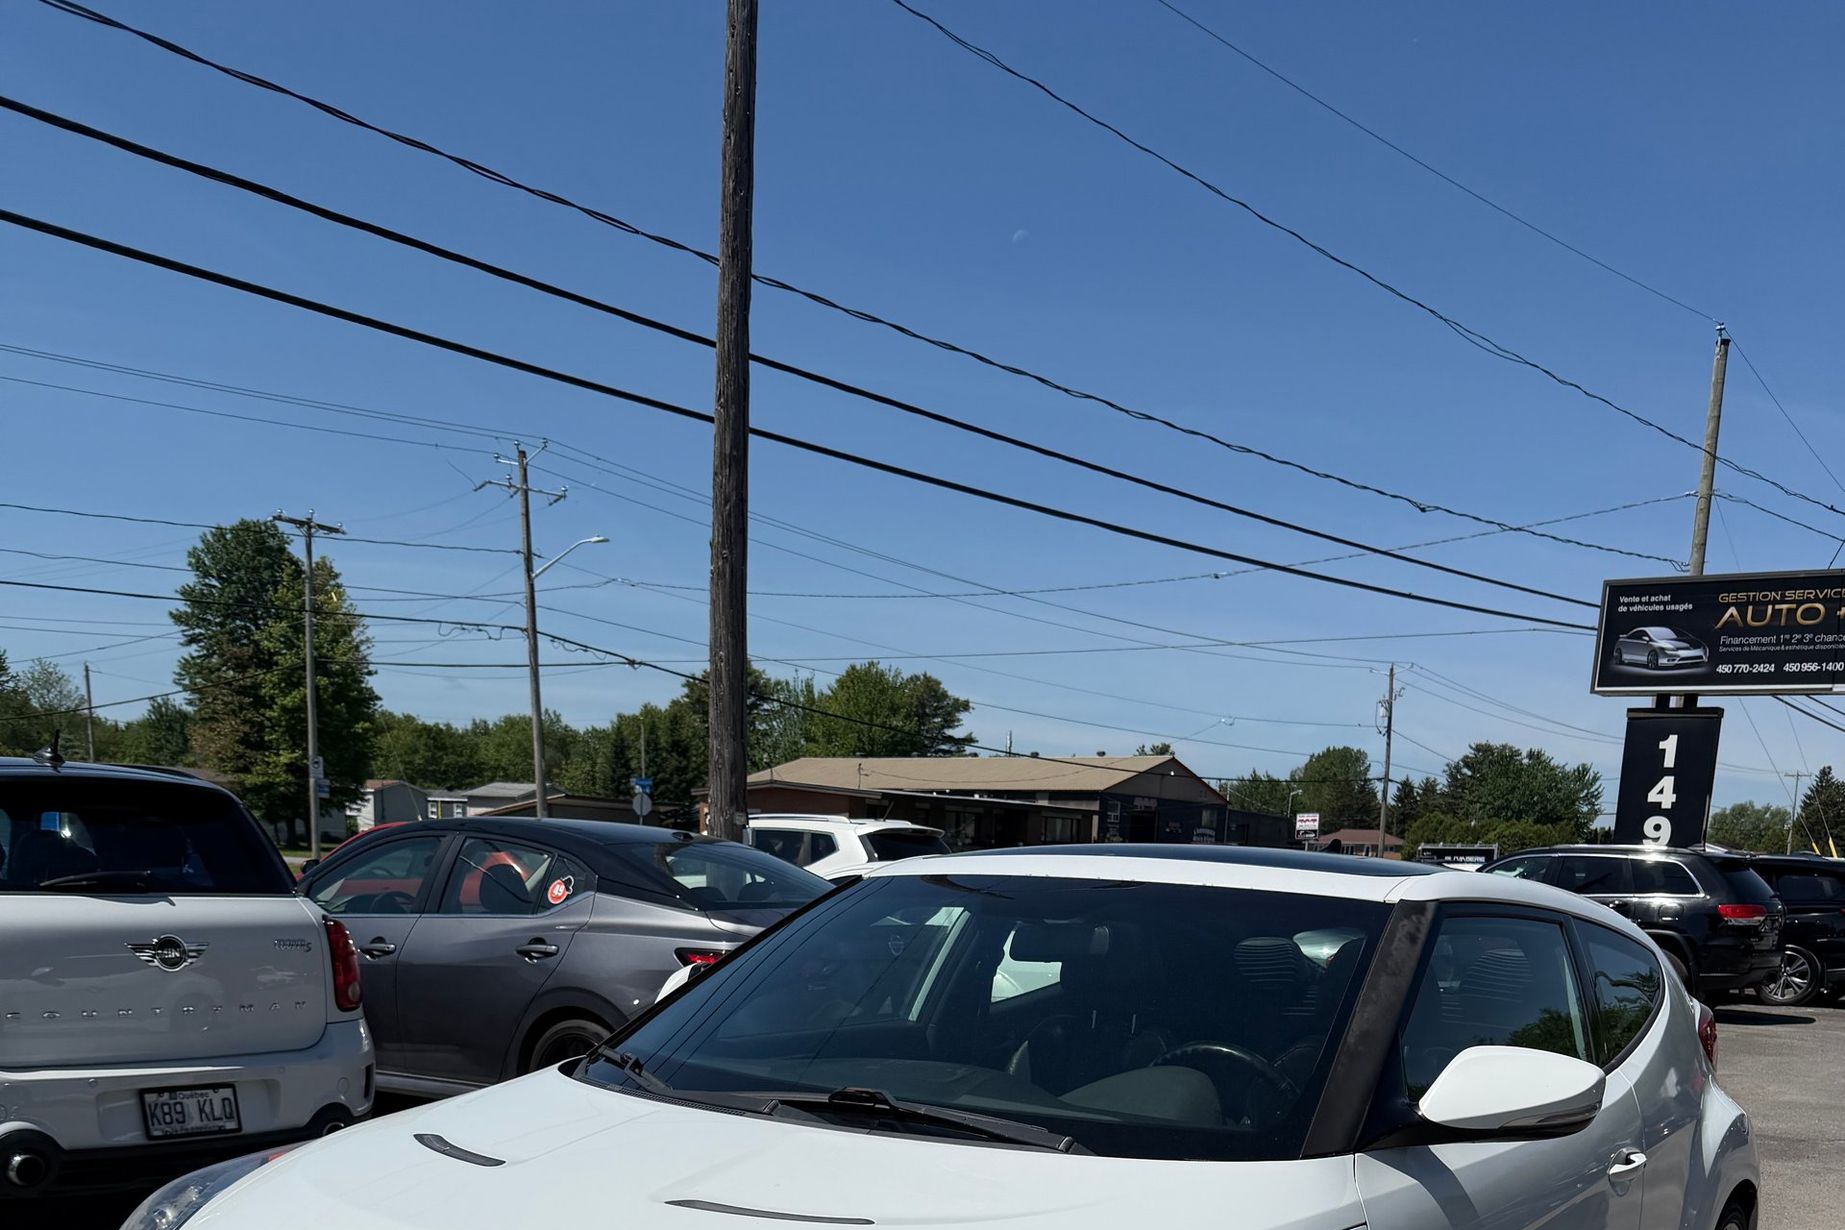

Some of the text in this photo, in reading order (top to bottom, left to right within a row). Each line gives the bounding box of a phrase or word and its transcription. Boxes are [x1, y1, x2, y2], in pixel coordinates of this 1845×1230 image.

[1650, 594, 1671, 602] achat
[1719, 591, 1781, 603] GESTION
[1629, 604, 1664, 612] véhicules
[1665, 602, 1693, 612] usagés
[1714, 603, 1826, 629] AUTO
[1720, 635, 1777, 645] Financement
[1716, 661, 1845, 674] 450 770-2424 450 956-1400
[148, 1101, 187, 1127] K89
